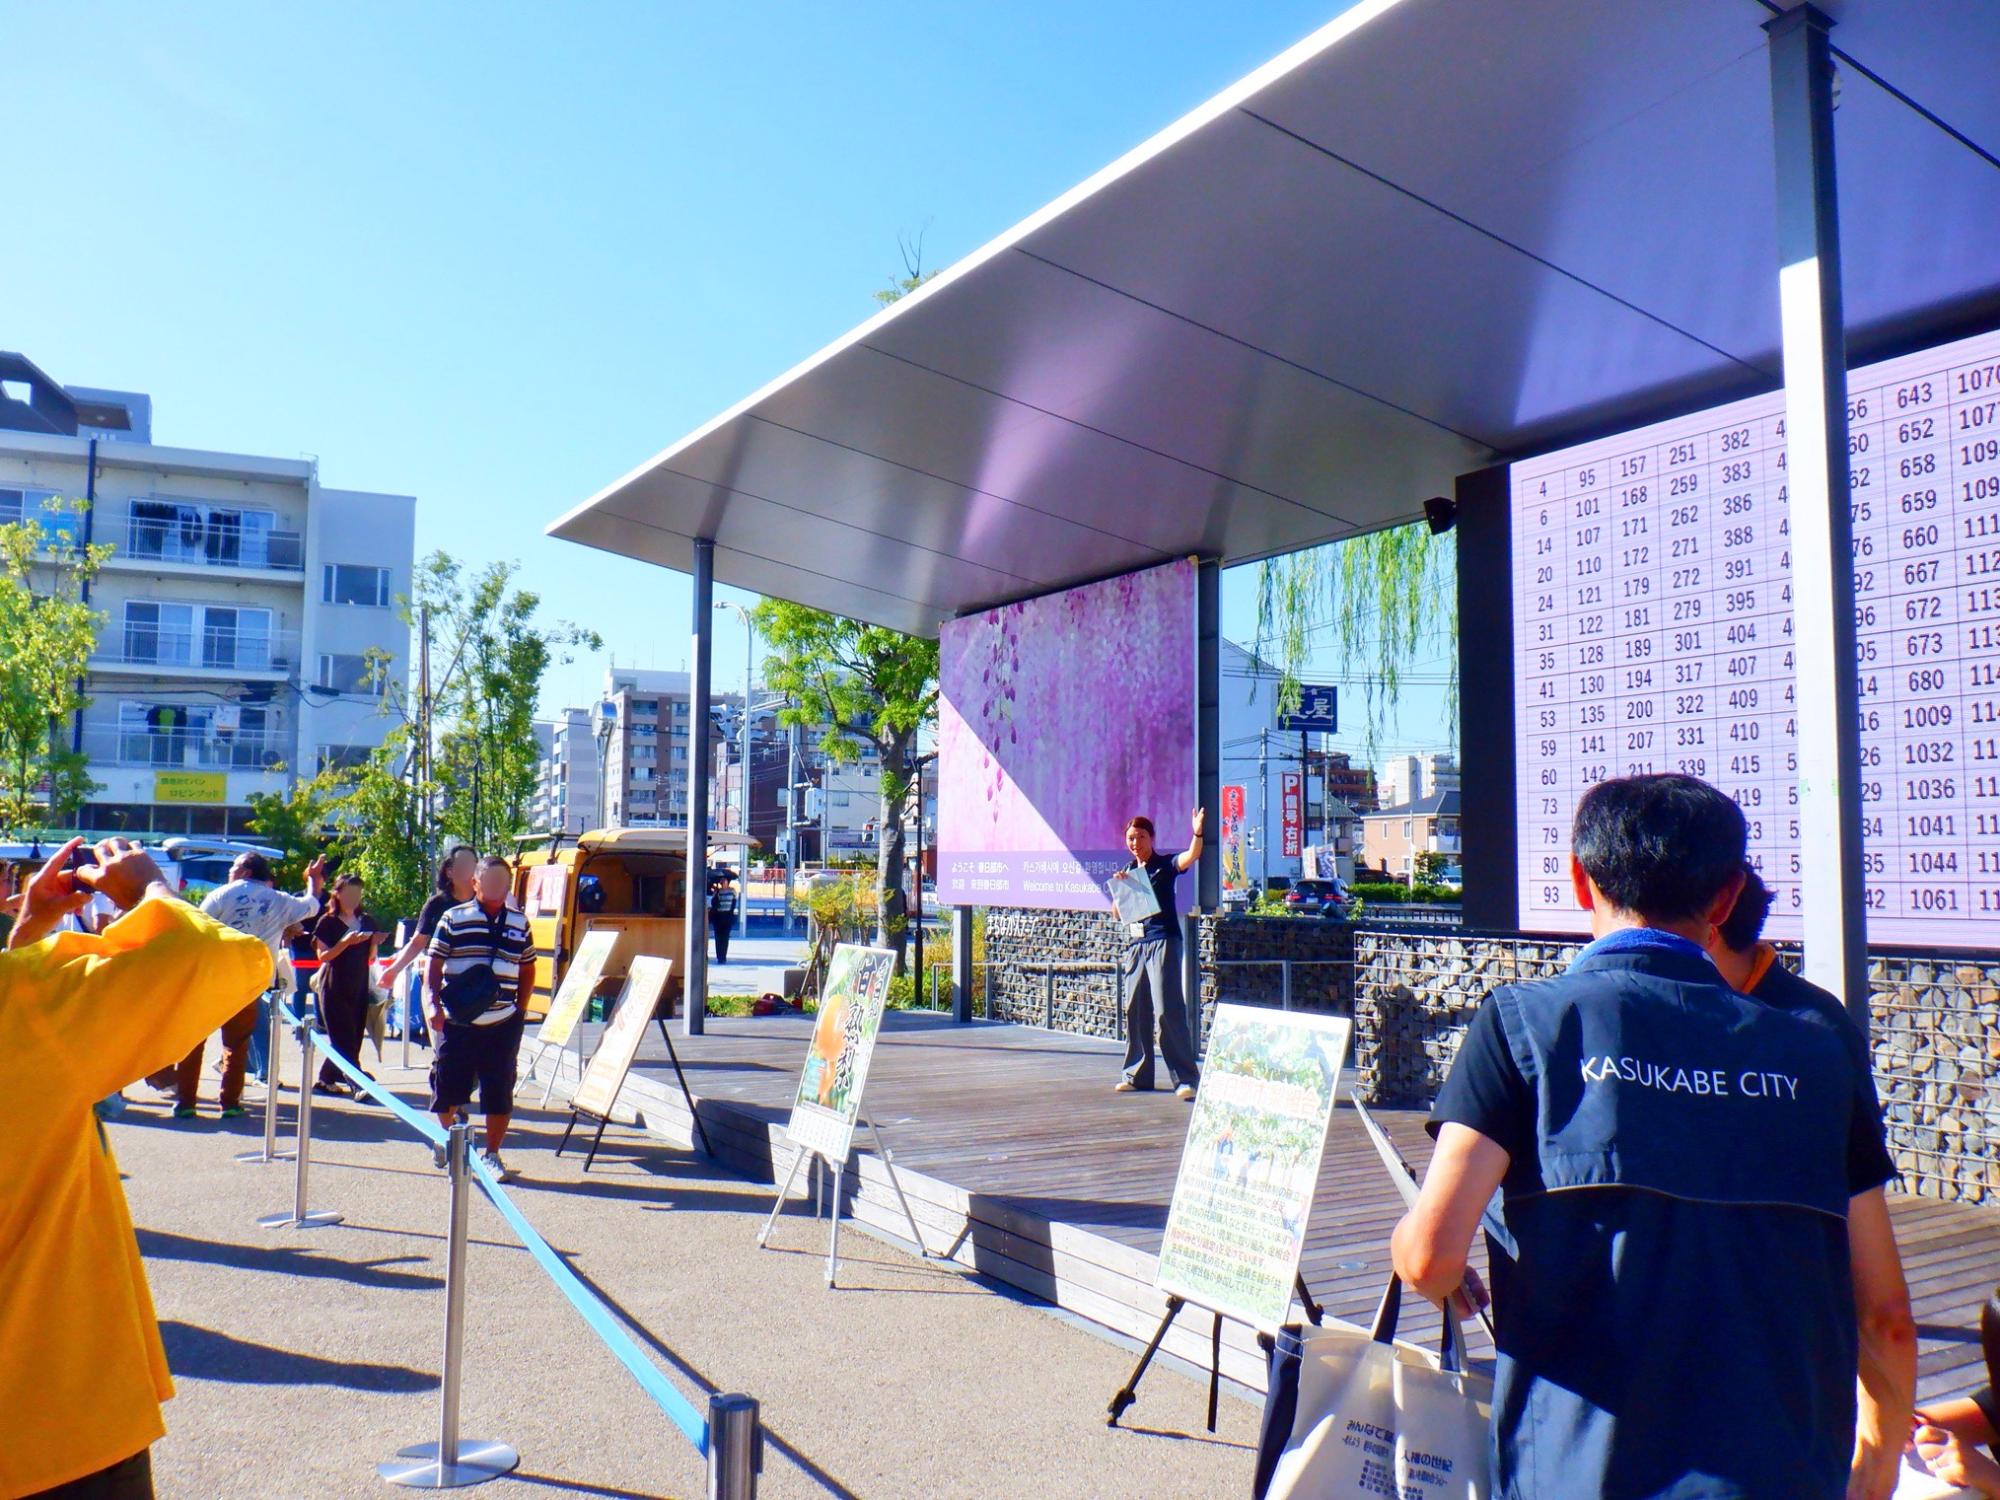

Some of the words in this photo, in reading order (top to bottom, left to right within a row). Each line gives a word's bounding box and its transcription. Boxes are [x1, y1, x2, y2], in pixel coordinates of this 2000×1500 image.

[1540, 481, 1547, 496] 4
[1580, 469, 1595, 488] 95
[1622, 456, 1646, 477] 157
[1670, 442, 1696, 465] 251
[1722, 429, 1750, 452] 382
[1898, 382, 1932, 408] 643
[1540, 510, 1547, 526] 6
[1576, 498, 1600, 518] 101
[1622, 486, 1647, 507] 168
[1670, 474, 1697, 496] 259
[1722, 461, 1751, 484] 383
[1900, 418, 1934, 443] 652
[1538, 538, 1552, 555] 14
[1577, 527, 1600, 546] 107
[1623, 516, 1648, 536] 171
[1672, 505, 1698, 526] 262
[1723, 494, 1752, 515] 386
[1901, 454, 1935, 478] 658
[1538, 566, 1552, 583] 20
[1578, 556, 1601, 576] 110
[1624, 546, 1648, 567] 172
[1672, 537, 1698, 557] 271
[1724, 526, 1753, 547] 388
[1902, 490, 1936, 513] 659
[1538, 594, 1553, 612] 24
[1578, 586, 1602, 605] 121
[1624, 577, 1649, 597] 179
[1673, 568, 1700, 588] 272
[1725, 558, 1753, 580] 391
[1904, 525, 1938, 549] 660
[1539, 624, 1554, 641] 31
[1579, 615, 1602, 635] 122
[1625, 608, 1650, 628] 181
[1674, 599, 1701, 620] 279
[1727, 590, 1754, 612] 395
[1905, 561, 1939, 584] 667
[1540, 652, 1554, 670] 35
[1580, 646, 1603, 664] 128
[1626, 638, 1650, 658] 189
[1675, 631, 1702, 652] 301
[1727, 623, 1756, 643] 404
[1906, 597, 1941, 620] 672
[1540, 682, 1554, 698] 41
[1580, 675, 1604, 694] 130
[1627, 669, 1652, 688] 194
[1676, 662, 1702, 683] 317
[1728, 656, 1756, 676] 407
[1907, 633, 1943, 656] 673
[1541, 710, 1556, 727] 53
[1581, 705, 1605, 724] 135
[1627, 700, 1652, 719] 200
[1676, 694, 1703, 714] 322
[1729, 689, 1758, 709] 409
[1909, 669, 1944, 692] 680
[1541, 740, 1556, 756] 59
[1582, 736, 1605, 753] 141
[1628, 731, 1653, 750] 207
[1678, 727, 1704, 746] 331
[1730, 722, 1759, 741] 410
[1904, 706, 1952, 728] 1009
[1542, 769, 1556, 785] 60
[1583, 766, 1606, 782] 142
[1629, 762, 1653, 775] 211
[1678, 758, 1705, 776] 339
[1731, 756, 1760, 774] 415
[1906, 742, 1954, 764] 1032
[1542, 798, 1557, 814] 73
[1732, 788, 1761, 806] 419
[1907, 778, 1955, 800] 1036
[1542, 827, 1558, 844] 79
[1908, 816, 1956, 836] 1041
[1024, 880, 1055, 891] Welcome
[1065, 880, 1101, 893] Kasukabe
[1544, 857, 1558, 873] 80
[1910, 852, 1957, 872] 1044
[1544, 886, 1559, 903] 93
[1910, 889, 1958, 910] 1061
[1581, 1056, 1729, 1096] KASUKABE
[1740, 1072, 1799, 1101] CITY
